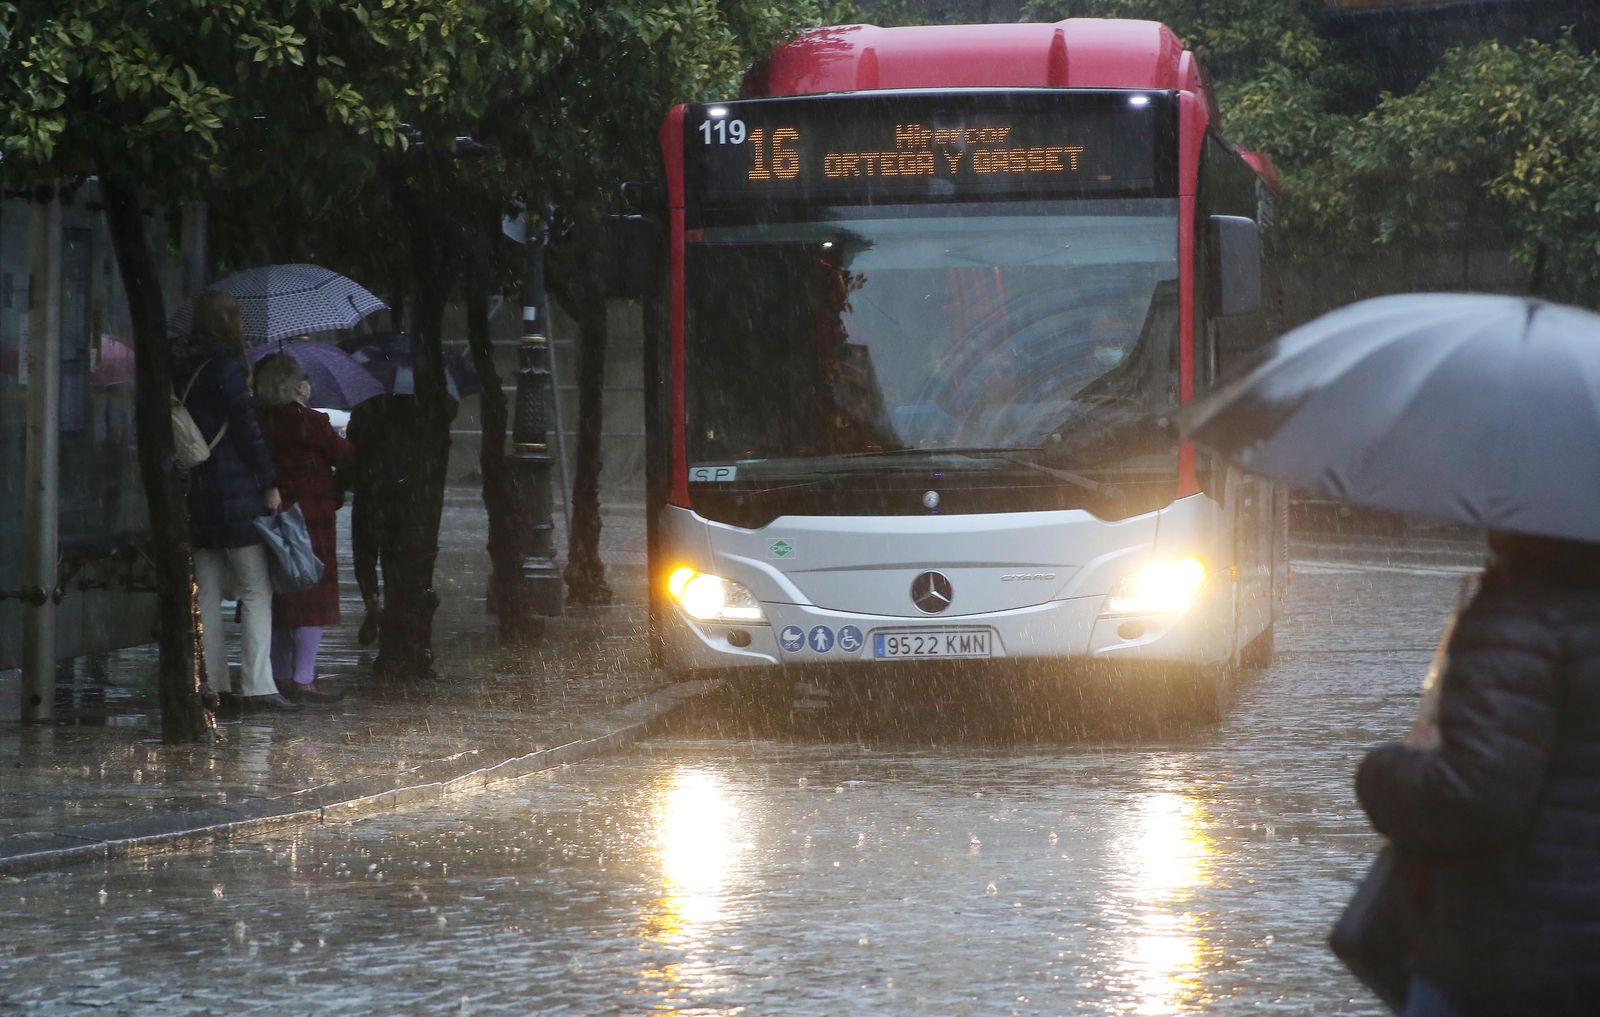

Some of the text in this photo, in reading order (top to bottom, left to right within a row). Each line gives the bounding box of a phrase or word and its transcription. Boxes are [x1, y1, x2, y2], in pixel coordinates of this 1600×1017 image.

[699, 119, 746, 145] 119
[748, 128, 799, 179] 16
[824, 146, 1083, 177] ORTEGA Y GASSET
[887, 636, 938, 655] 9522
[946, 634, 985, 654] KMN
